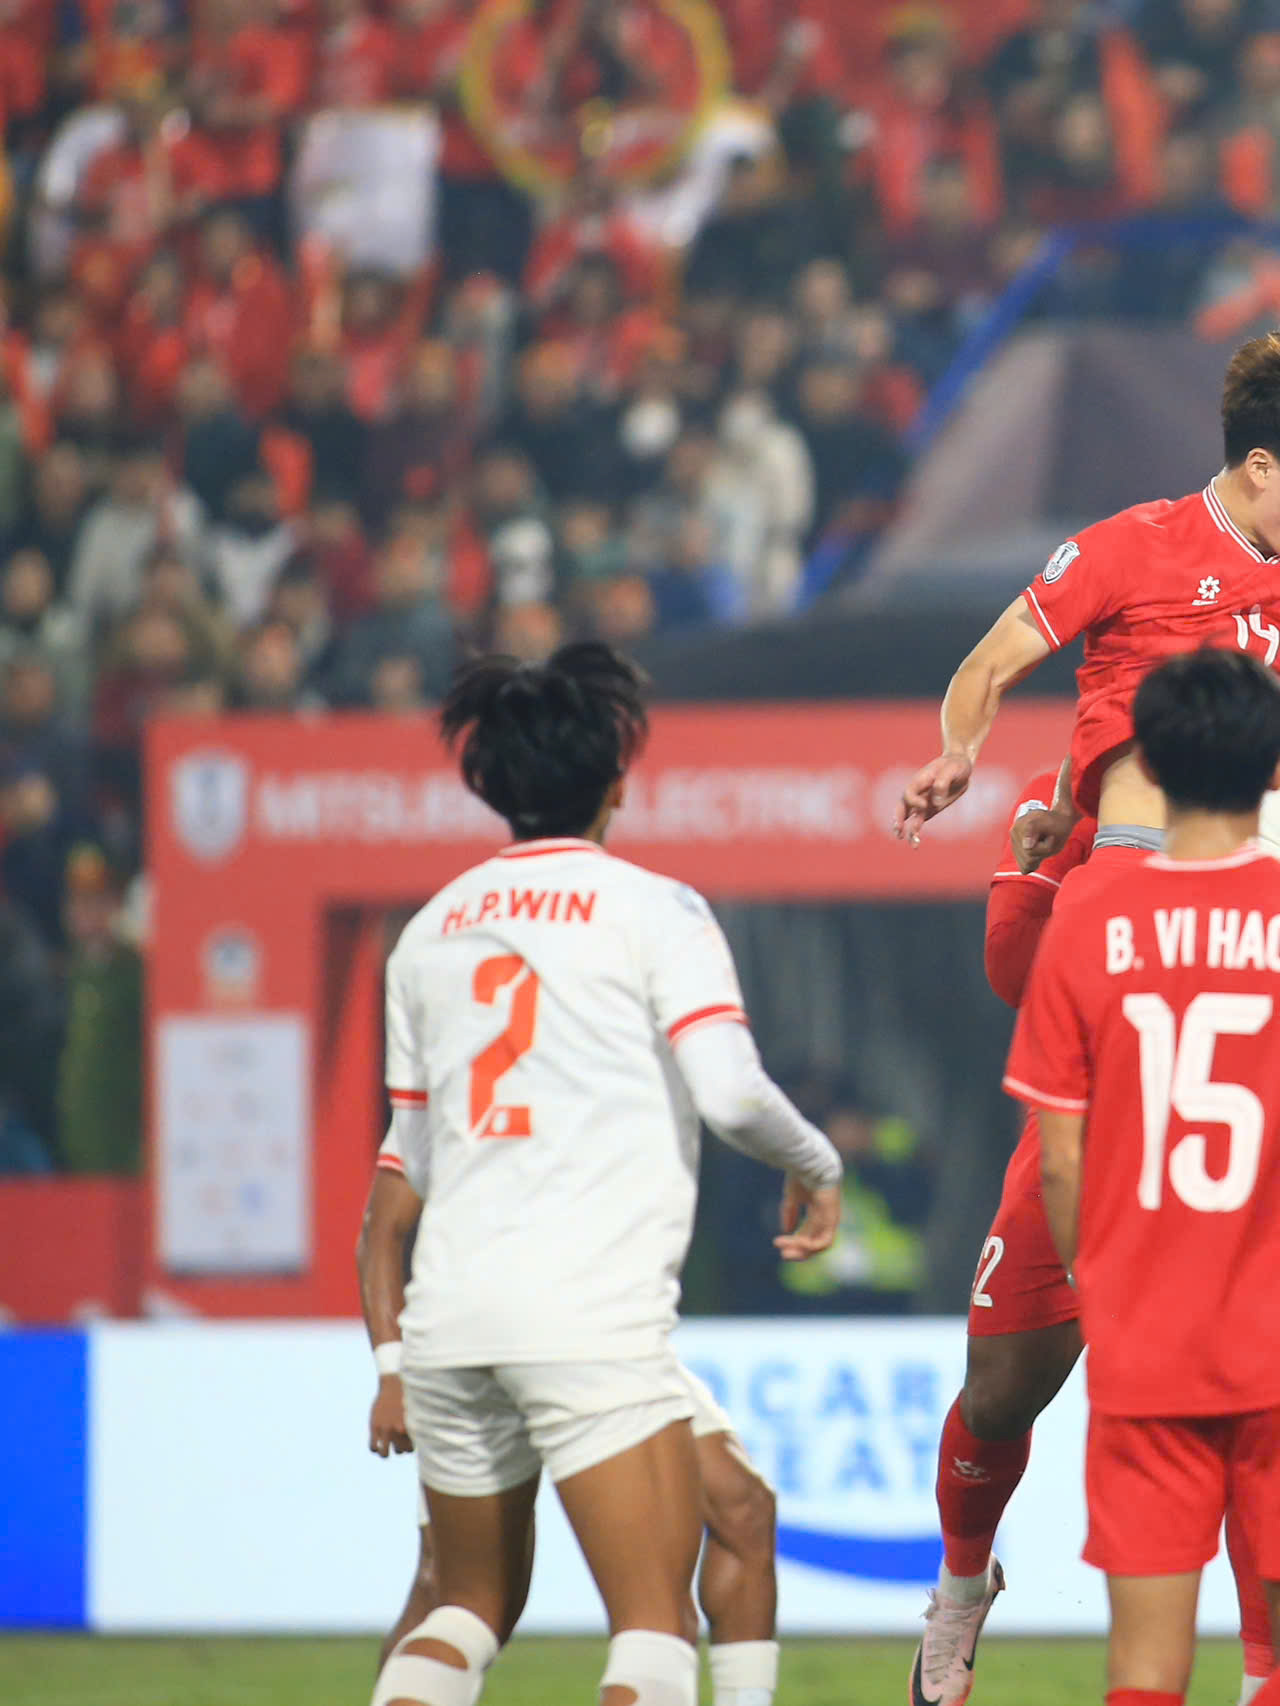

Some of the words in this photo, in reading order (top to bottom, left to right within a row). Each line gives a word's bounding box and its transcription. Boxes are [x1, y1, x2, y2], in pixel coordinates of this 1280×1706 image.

[1231, 603, 1280, 668] 14
[604, 766, 866, 842] LECTRIC
[442, 887, 598, 937] H.P.WIN
[1105, 914, 1146, 976] B.
[1153, 906, 1198, 970] VI
[467, 951, 535, 1141] 2
[1121, 990, 1275, 1214] 15
[971, 1235, 1005, 1308] 2
